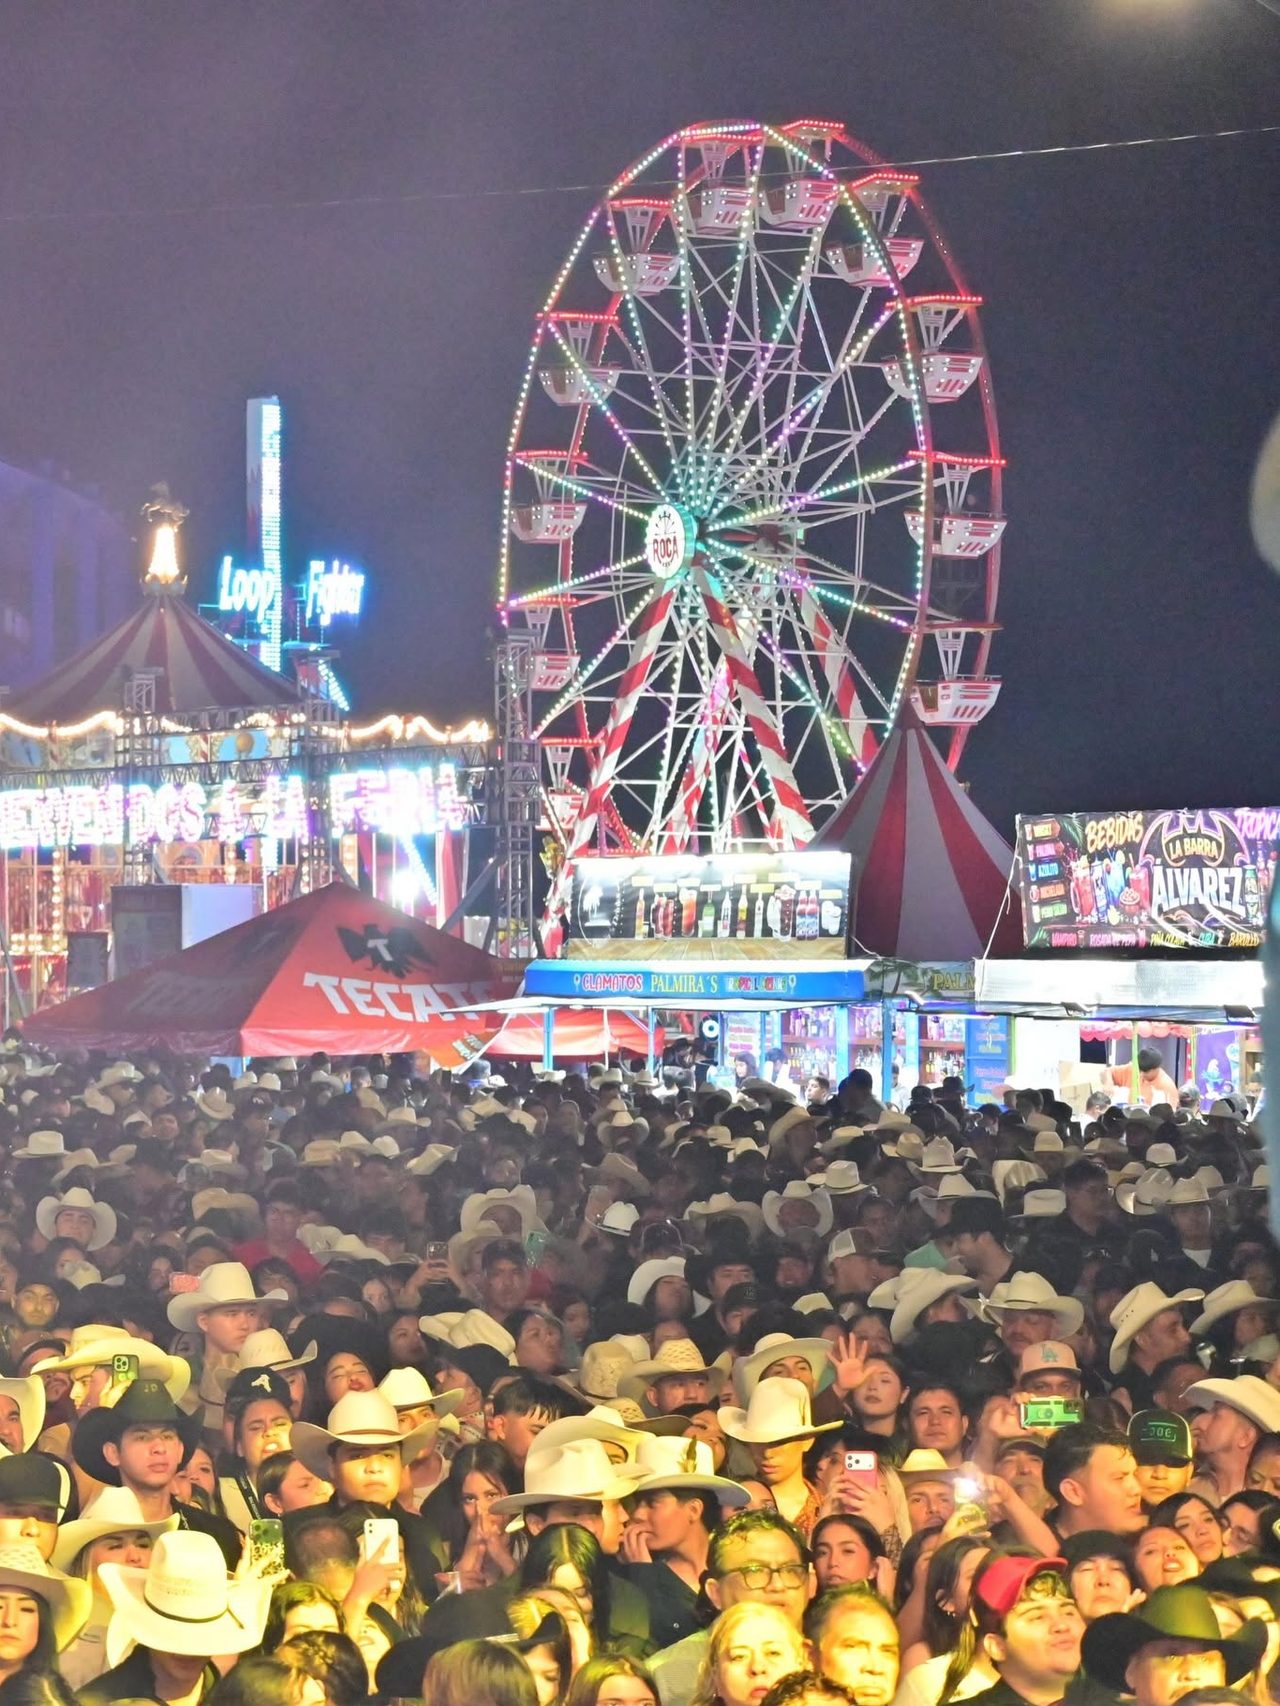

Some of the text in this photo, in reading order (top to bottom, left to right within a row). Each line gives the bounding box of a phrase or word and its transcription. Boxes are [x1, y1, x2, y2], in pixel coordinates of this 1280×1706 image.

[652, 535, 679, 564] ROCA
[220, 556, 276, 622] Loop
[1085, 812, 1143, 853] BEBIDAS
[1169, 837, 1219, 860] LA BARRA
[1151, 858, 1247, 920] ÁLVAREZ
[582, 973, 644, 992] CLAMATOS
